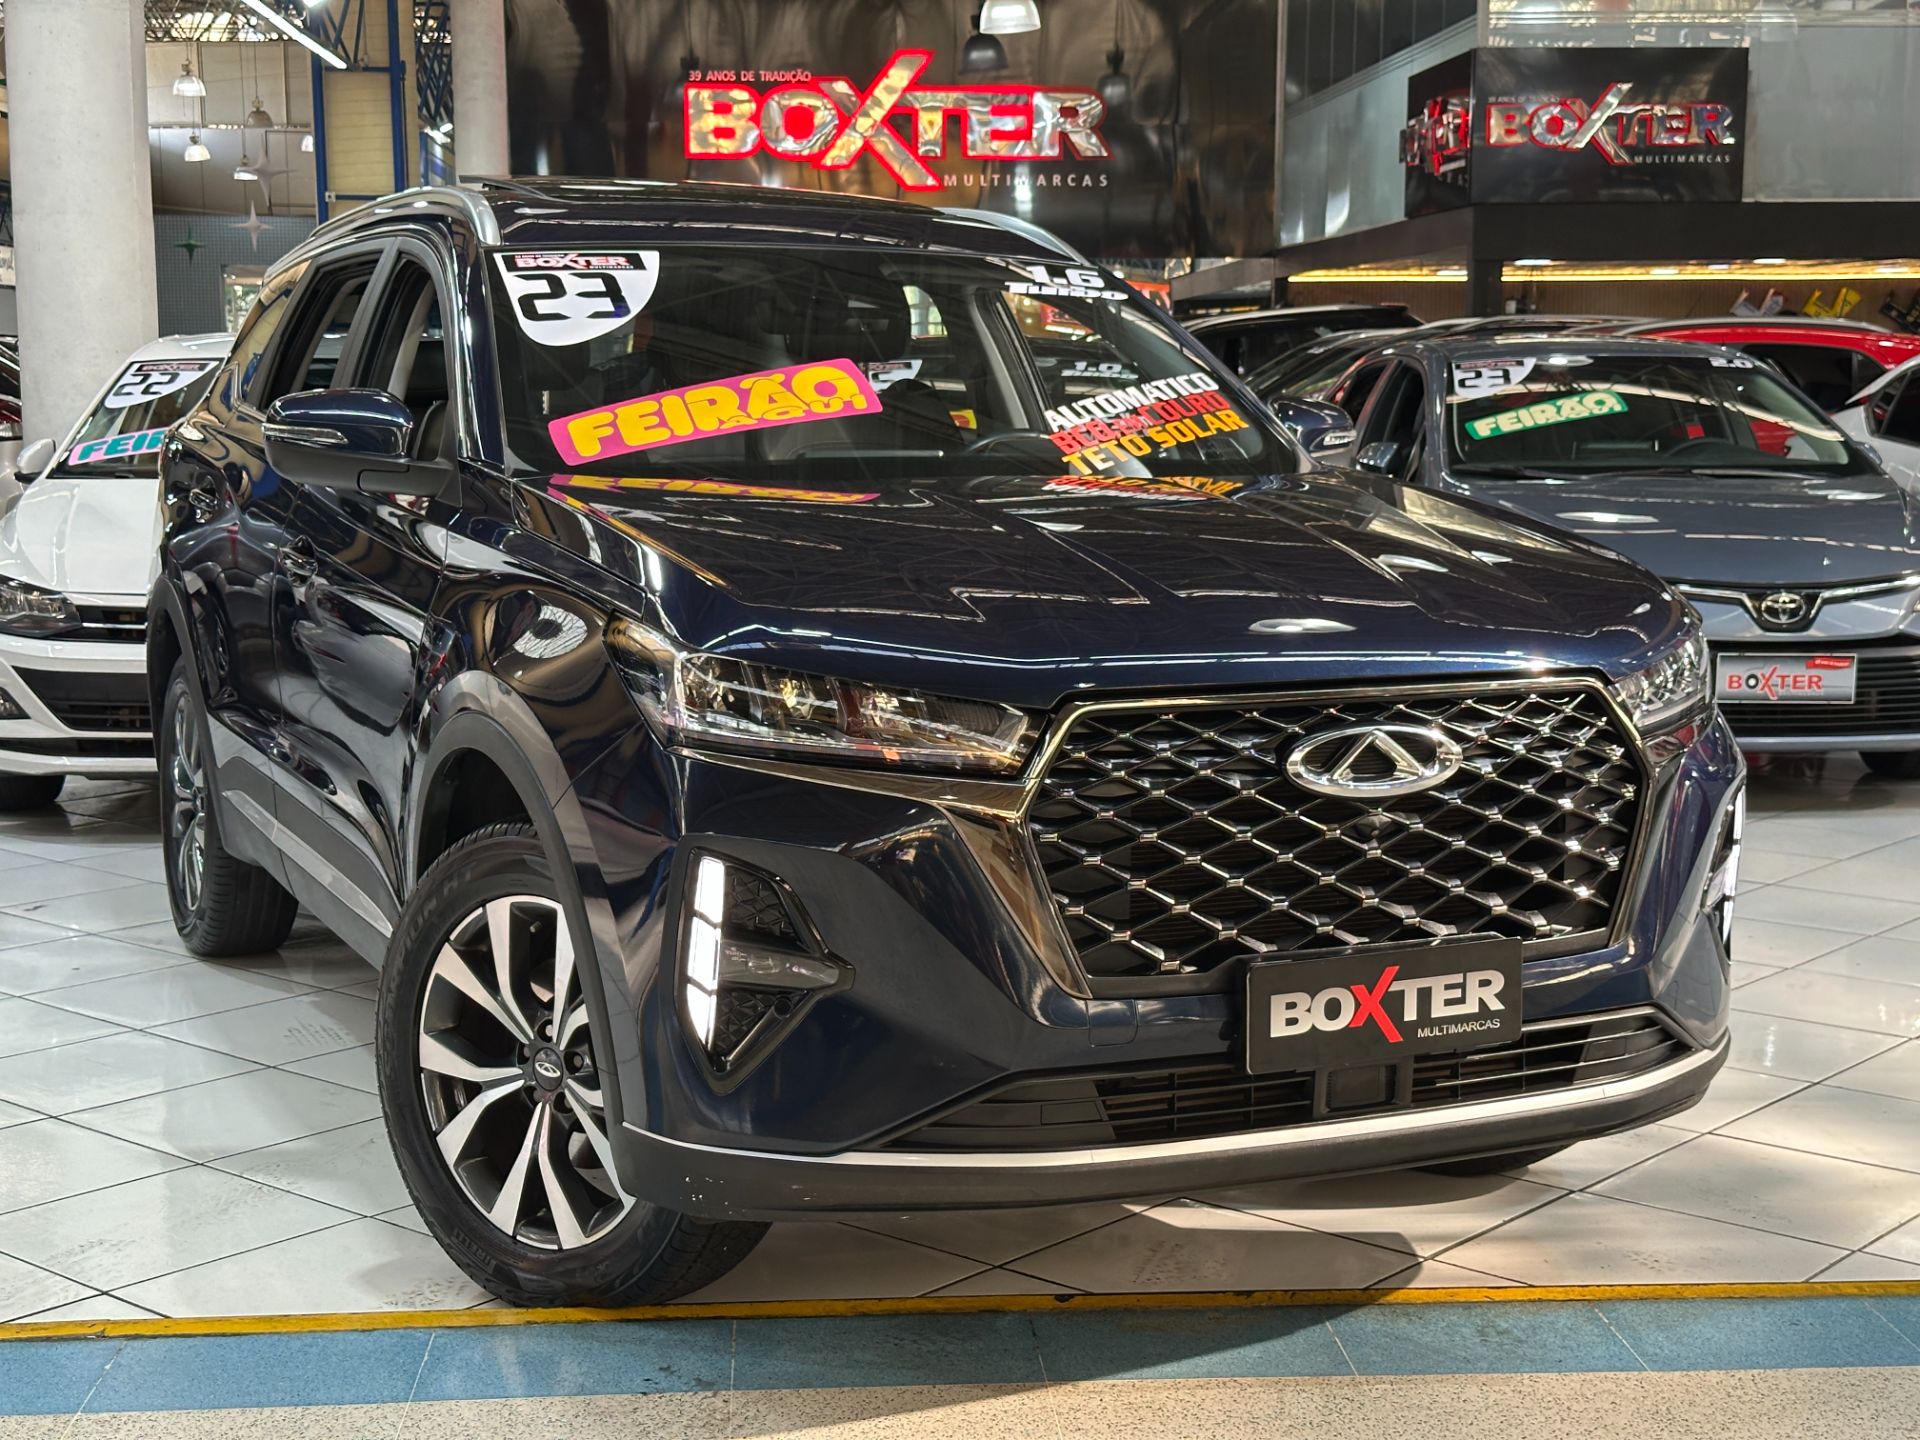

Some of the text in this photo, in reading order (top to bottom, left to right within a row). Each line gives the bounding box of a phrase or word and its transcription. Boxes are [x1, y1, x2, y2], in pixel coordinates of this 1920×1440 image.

[689, 69, 812, 83] 39 ANOS DE TRADIÇÃO
[683, 48, 1114, 192] BOXTER
[1485, 82, 1736, 165] BOXTER
[1634, 154, 1731, 164] MULTIMARCAS
[943, 174, 1108, 187] MULTIMARCAS
[515, 253, 631, 270] BOXTER
[1026, 265, 1105, 288] 1.6
[513, 272, 632, 322] 23
[1708, 356, 1754, 368] 2.0
[113, 373, 180, 396] 22
[1458, 368, 1511, 388] 23
[567, 365, 857, 457] FEIRÃO
[1138, 391, 1231, 426] COURO
[1474, 391, 1619, 437] FEIRÃO
[1062, 410, 1249, 475] TETO SOLAR
[1727, 665, 1824, 700] BOXTER
[1269, 965, 1506, 1043] BOXTER
[1417, 1018, 1501, 1038] MULTIMARCAS
